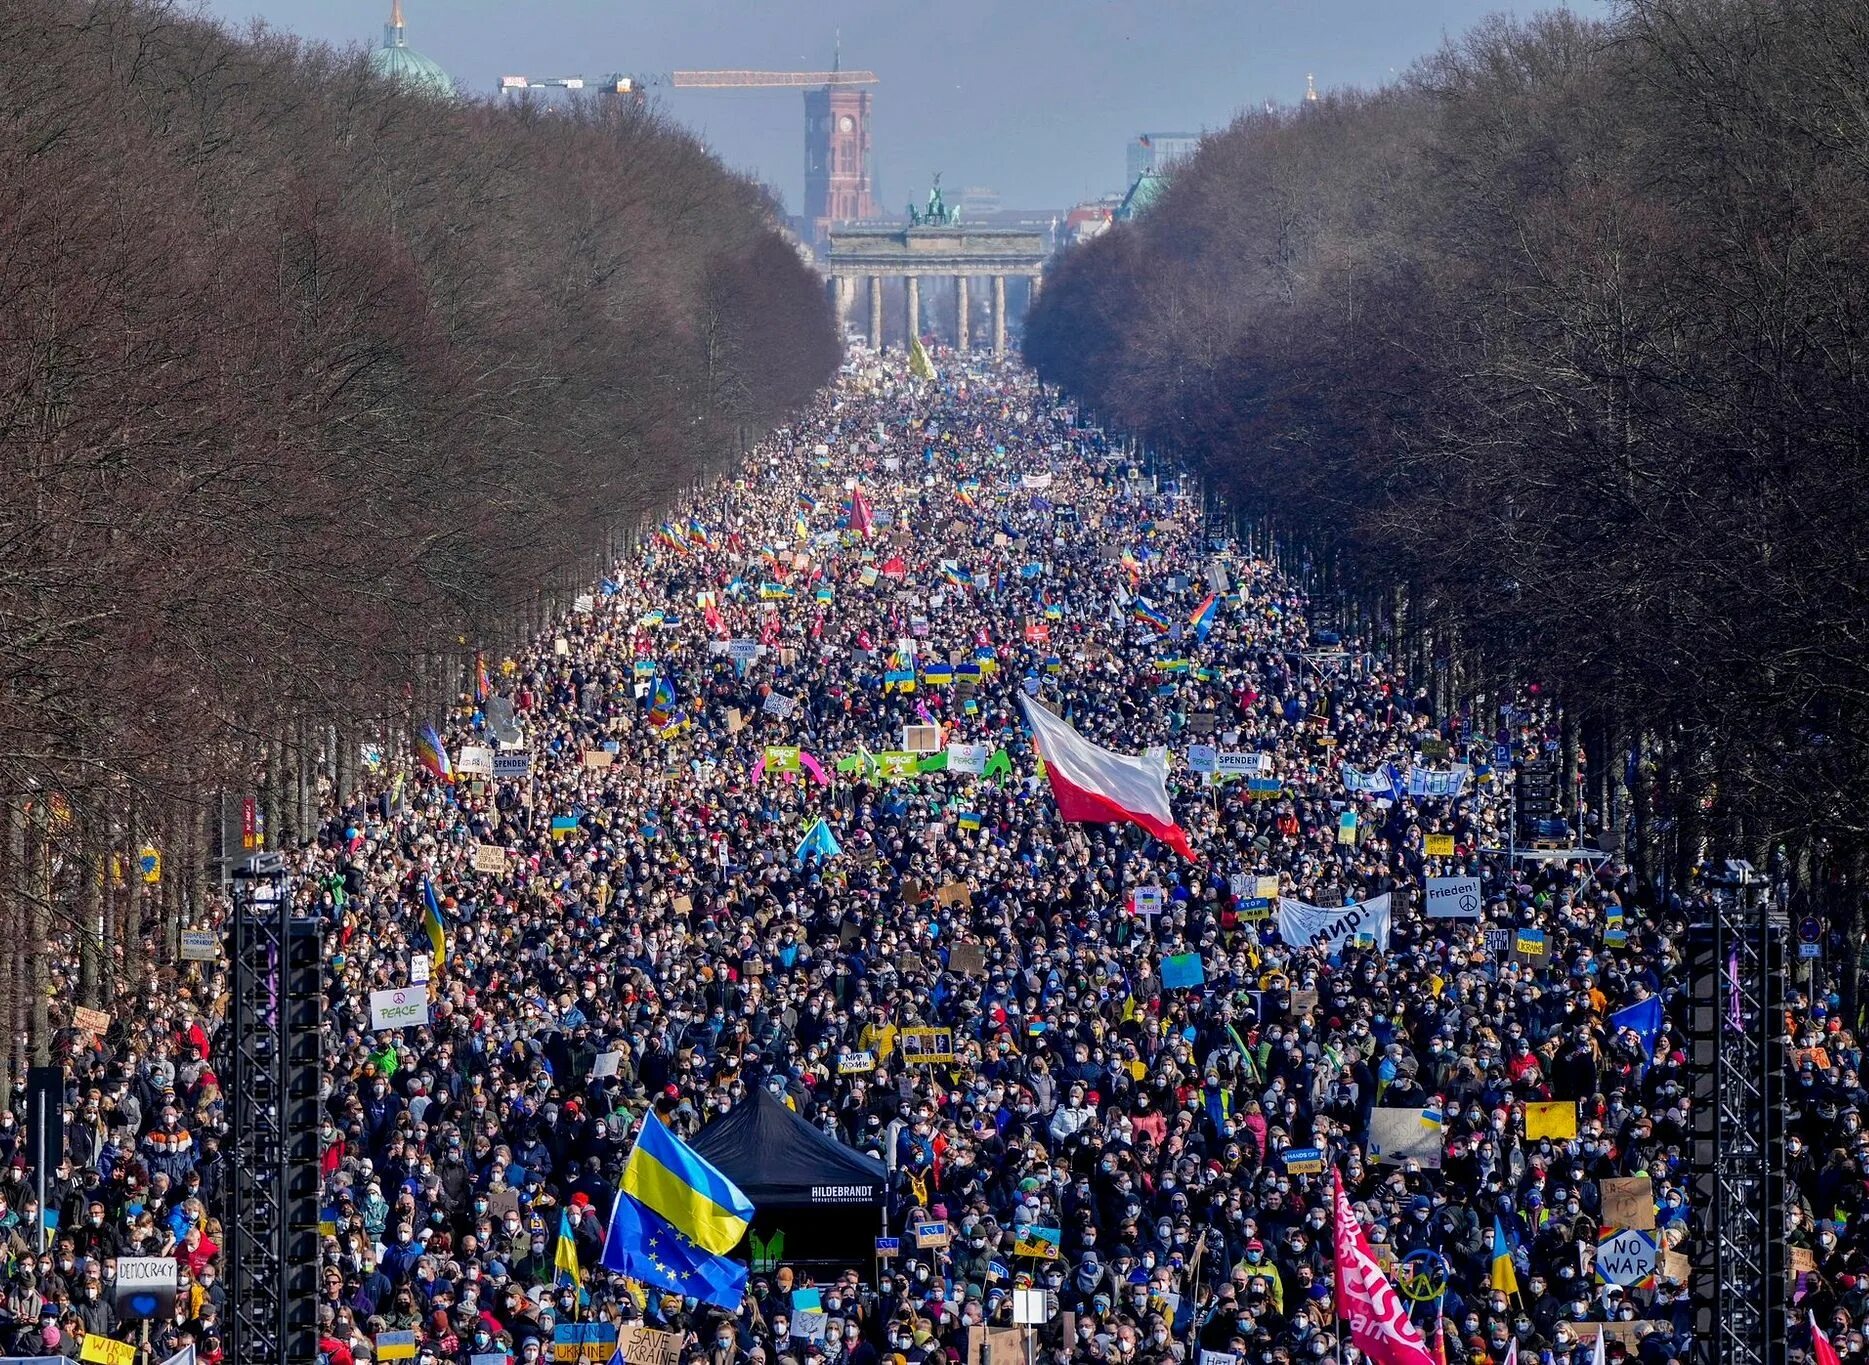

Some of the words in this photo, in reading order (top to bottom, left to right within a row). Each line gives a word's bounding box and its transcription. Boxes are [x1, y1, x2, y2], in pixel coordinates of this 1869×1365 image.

[768, 748, 797, 758] PEACE
[494, 759, 527, 768] SPENDEN
[885, 755, 915, 765] PEACE
[1219, 755, 1258, 765] SPENDEN
[1232, 874, 1258, 888] STOP
[1429, 881, 1478, 900] Frieden!
[1240, 900, 1261, 909] STOP
[1246, 909, 1263, 917] WAR
[1483, 930, 1508, 940] STOP
[1486, 940, 1508, 950] PUTIN
[379, 1003, 420, 1019] PEACE
[1287, 1152, 1307, 1160] HANDS
[811, 1185, 873, 1198] HILDEBRANDT
[1613, 1238, 1641, 1255] NO
[120, 1262, 174, 1280] DEMOCRACY
[1603, 1256, 1648, 1276] WAR
[562, 1324, 604, 1340] STAND
[92, 1337, 119, 1354] WIR
[629, 1328, 671, 1352] SAVE
[556, 1345, 605, 1359] UKRAINE
